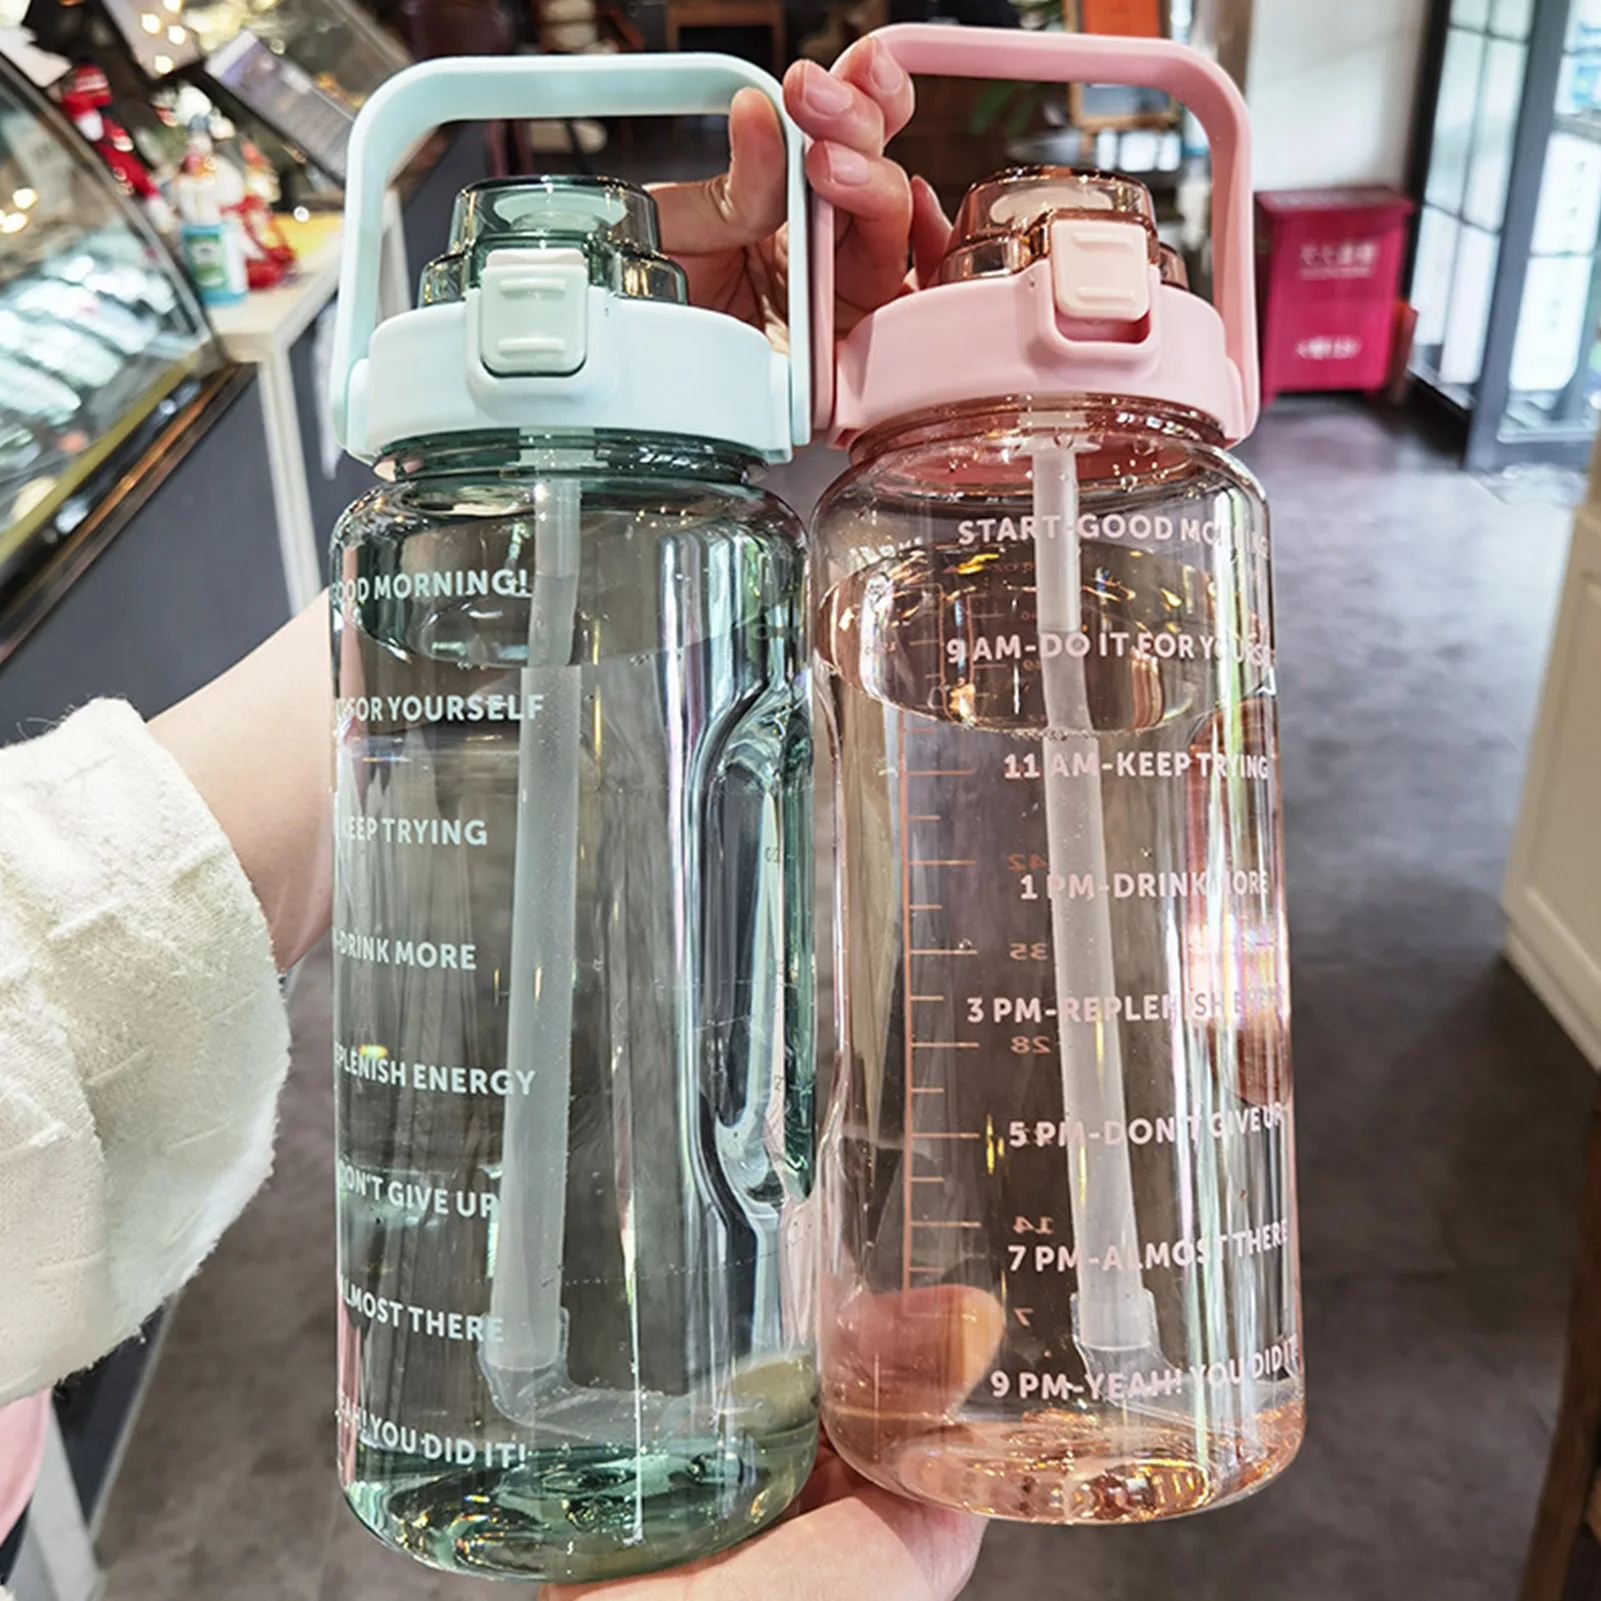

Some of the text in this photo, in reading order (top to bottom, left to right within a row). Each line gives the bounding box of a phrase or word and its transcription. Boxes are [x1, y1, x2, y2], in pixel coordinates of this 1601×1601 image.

[374, 568, 528, 600] MORNING!
[946, 637, 967, 664] 9
[973, 632, 1091, 661] AM-DO
[1100, 632, 1130, 658] IT
[1137, 632, 1195, 659] FOR
[387, 694, 545, 722] YOURSELF
[1003, 751, 1269, 780] 11 AM-KEEP TRYING
[381, 818, 488, 846] TRYING
[1020, 874, 1039, 899] 1
[1047, 872, 1207, 899] PM-DRINK
[395, 940, 477, 970] MORE
[967, 996, 984, 1023] 3
[993, 993, 1222, 1023] PM-REPLENSH
[412, 1062, 536, 1096] ENERGY
[1009, 1120, 1027, 1148] 5
[1035, 1115, 1201, 1148] PM-DONT
[1210, 1107, 1261, 1138] GIVE
[387, 1180, 449, 1215] GIVE
[456, 1191, 499, 1218] UP
[1007, 1218, 1288, 1273] 7 PM-ALMOST THERE
[342, 1278, 504, 1343] LMOST THERE
[990, 1369, 1010, 1398] 9
[1018, 1366, 1183, 1401] PM-YEAH!
[1189, 1356, 1245, 1391] YOU
[1251, 1343, 1285, 1380] DID
[369, 1413, 417, 1455] YOU
[421, 1431, 476, 1466] DID
[484, 1440, 527, 1469] IT!
